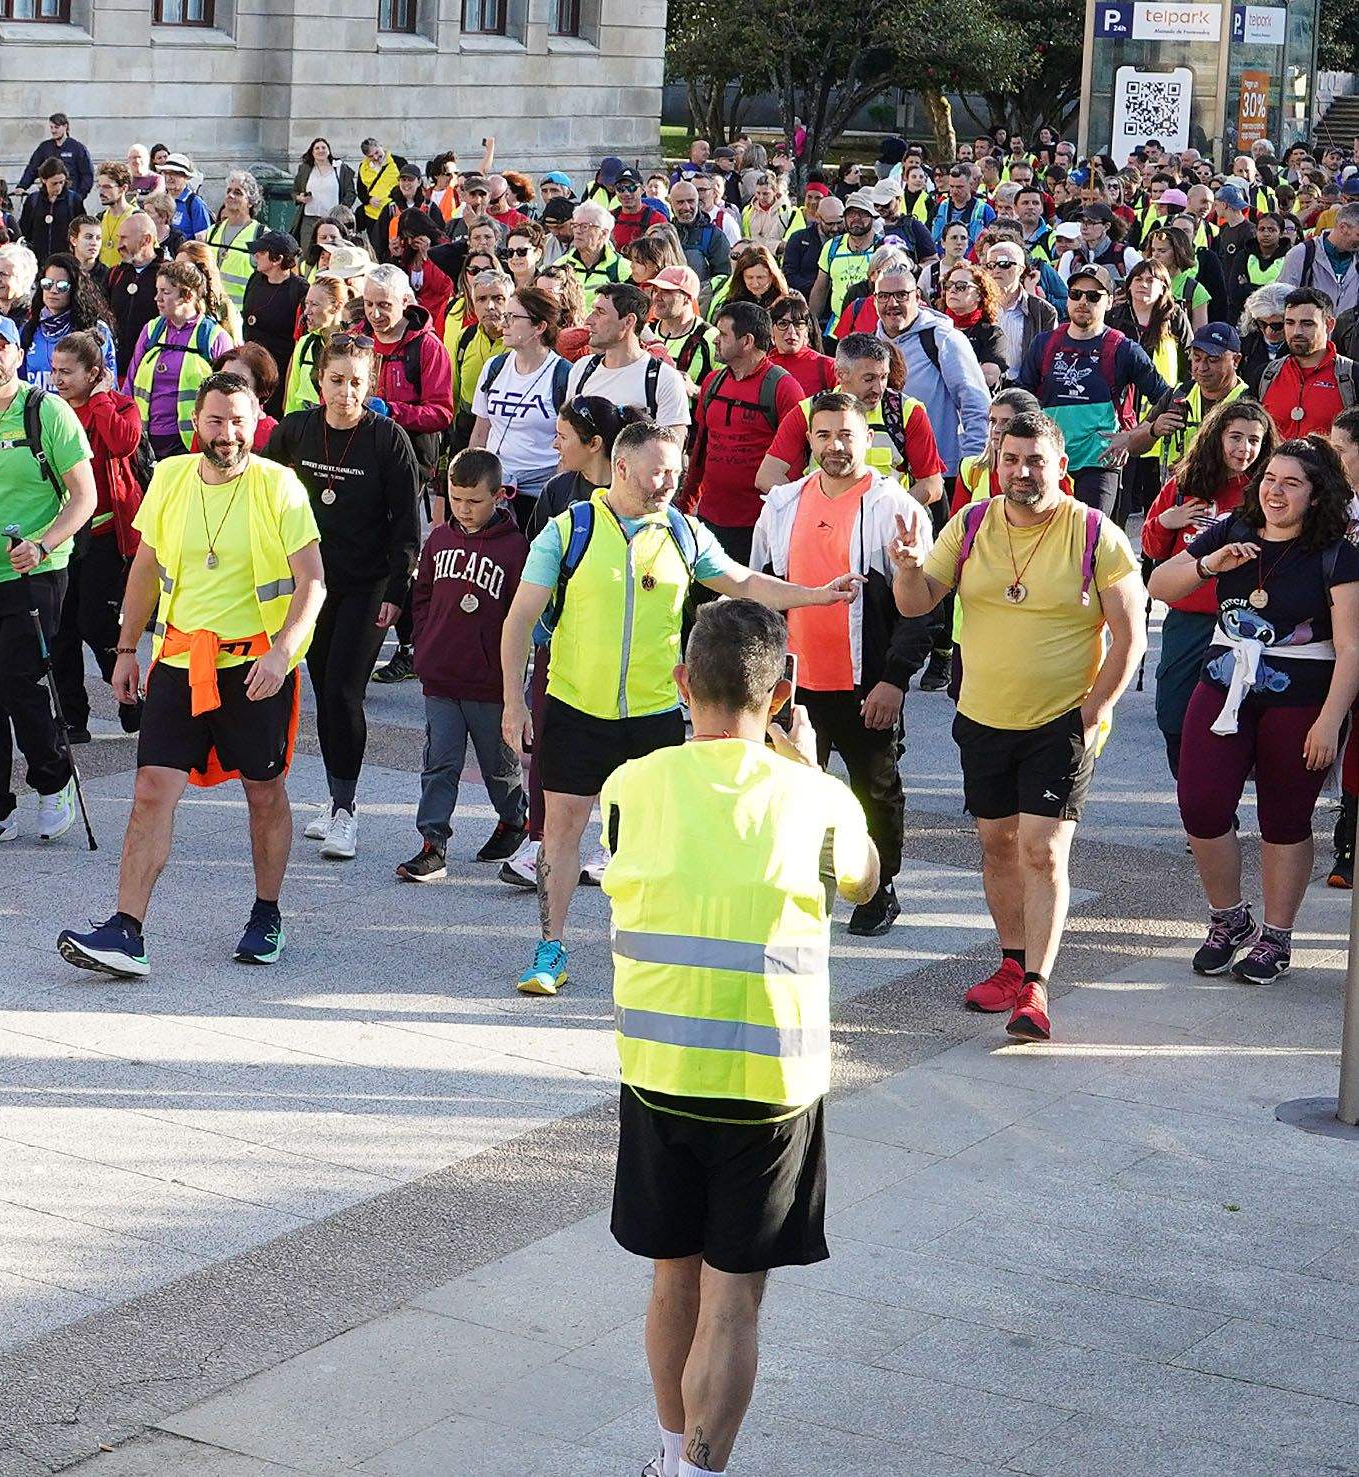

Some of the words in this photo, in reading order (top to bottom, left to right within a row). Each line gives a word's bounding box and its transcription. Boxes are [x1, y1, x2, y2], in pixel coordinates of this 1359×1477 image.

[1104, 9, 1122, 31] P
[1146, 9, 1210, 26] telpark
[1242, 92, 1266, 118] 30%
